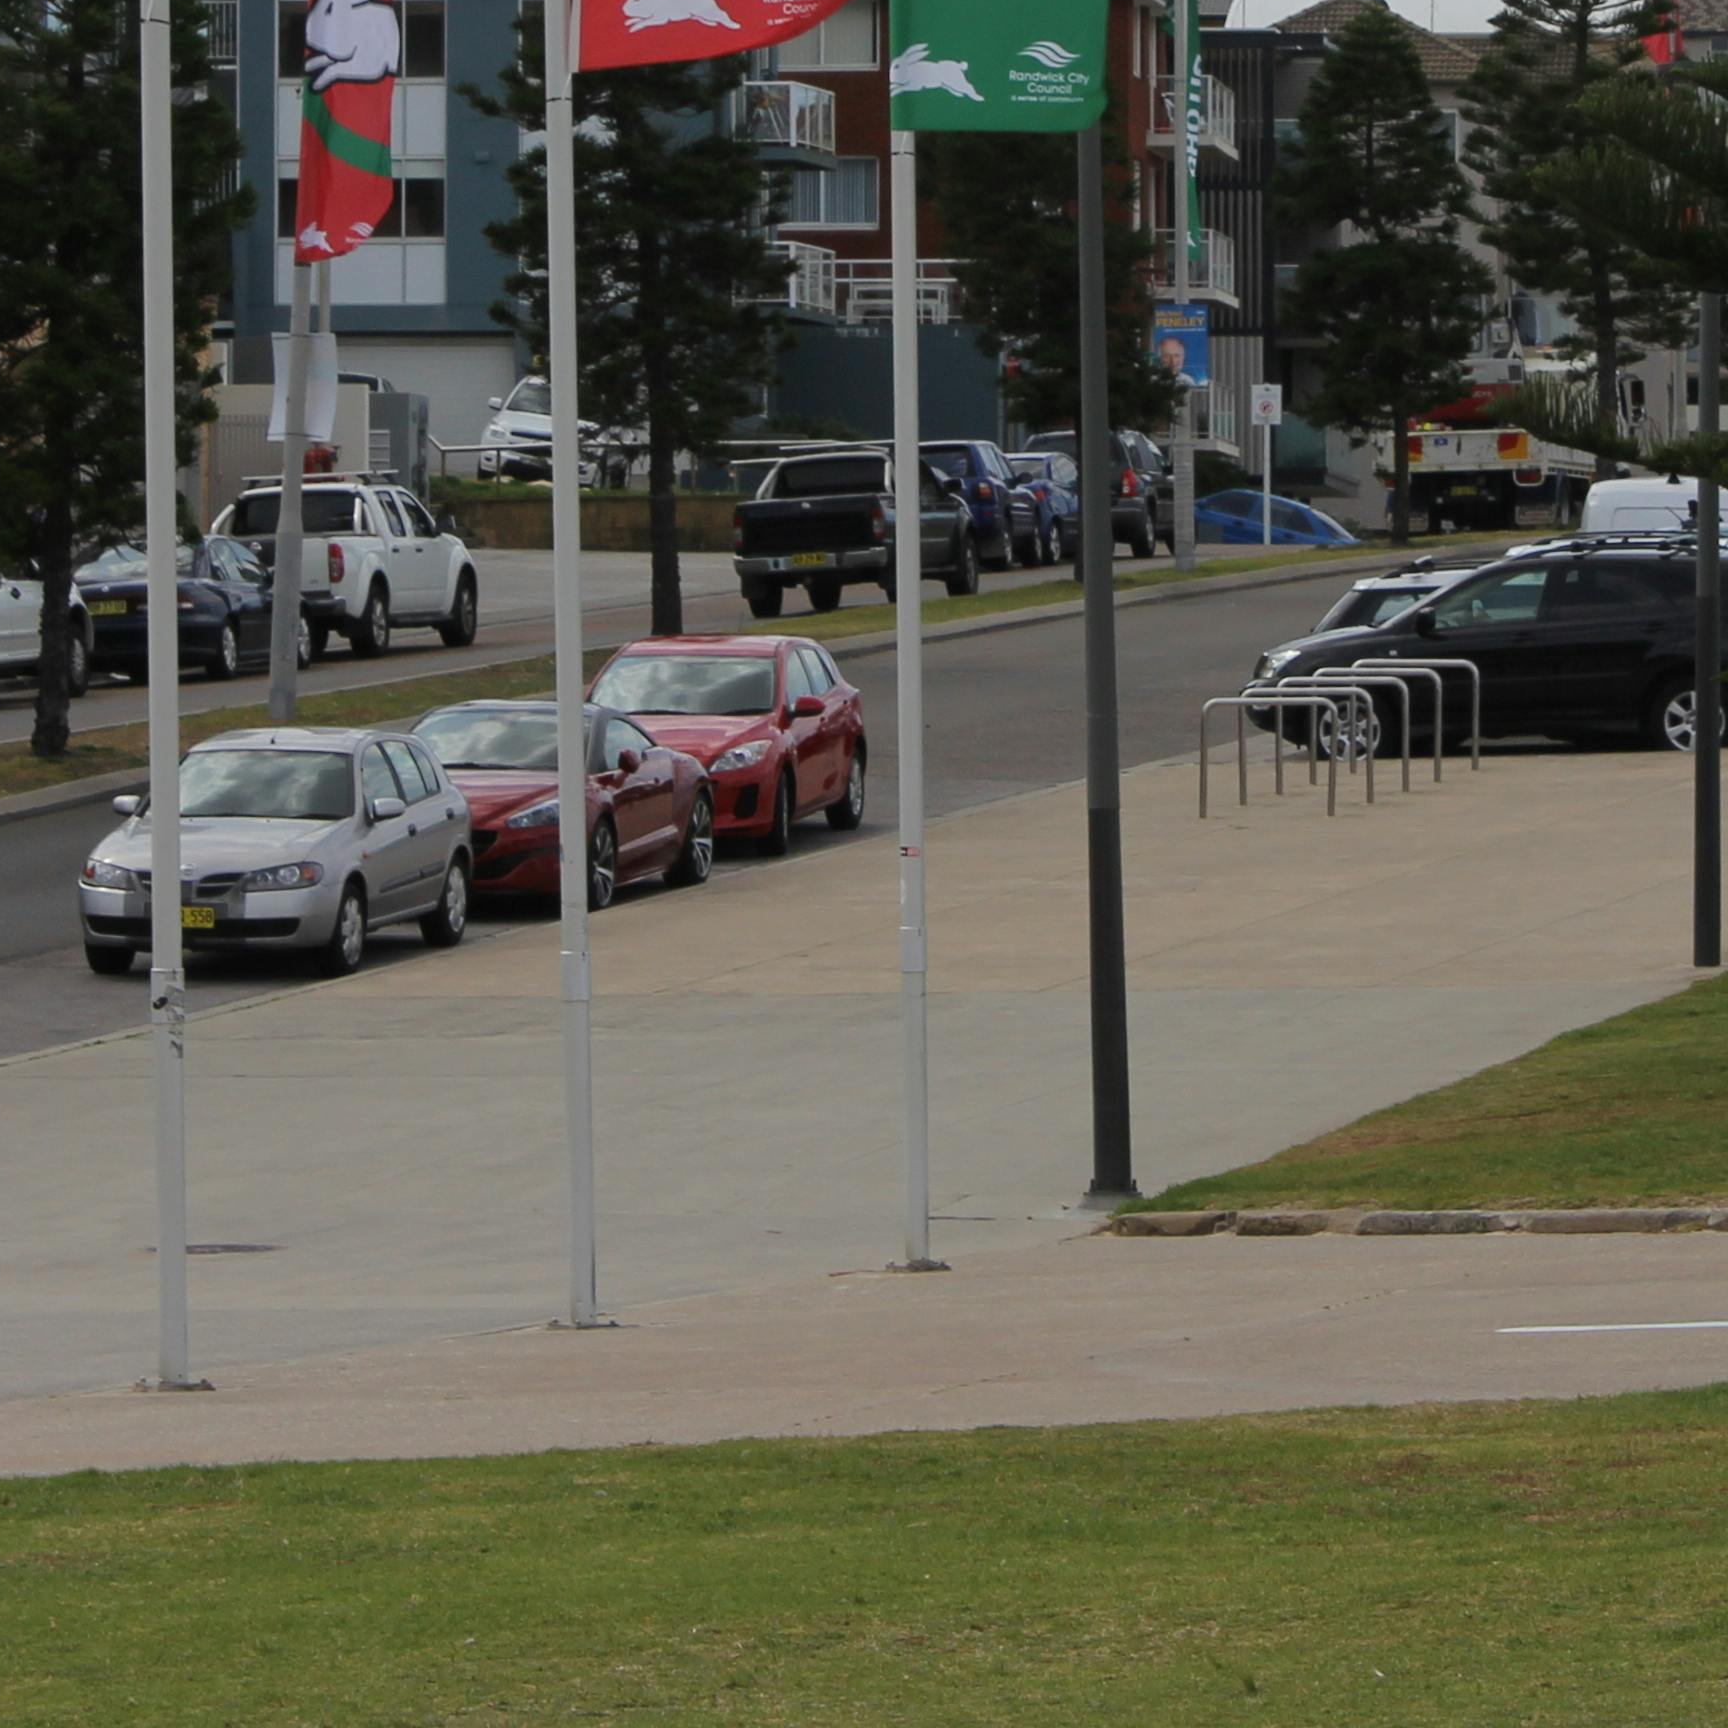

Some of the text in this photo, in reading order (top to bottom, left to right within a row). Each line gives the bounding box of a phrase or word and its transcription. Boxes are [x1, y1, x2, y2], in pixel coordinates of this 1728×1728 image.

[1009, 70, 1090, 85] Randwick City
[1027, 82, 1073, 94] Council
